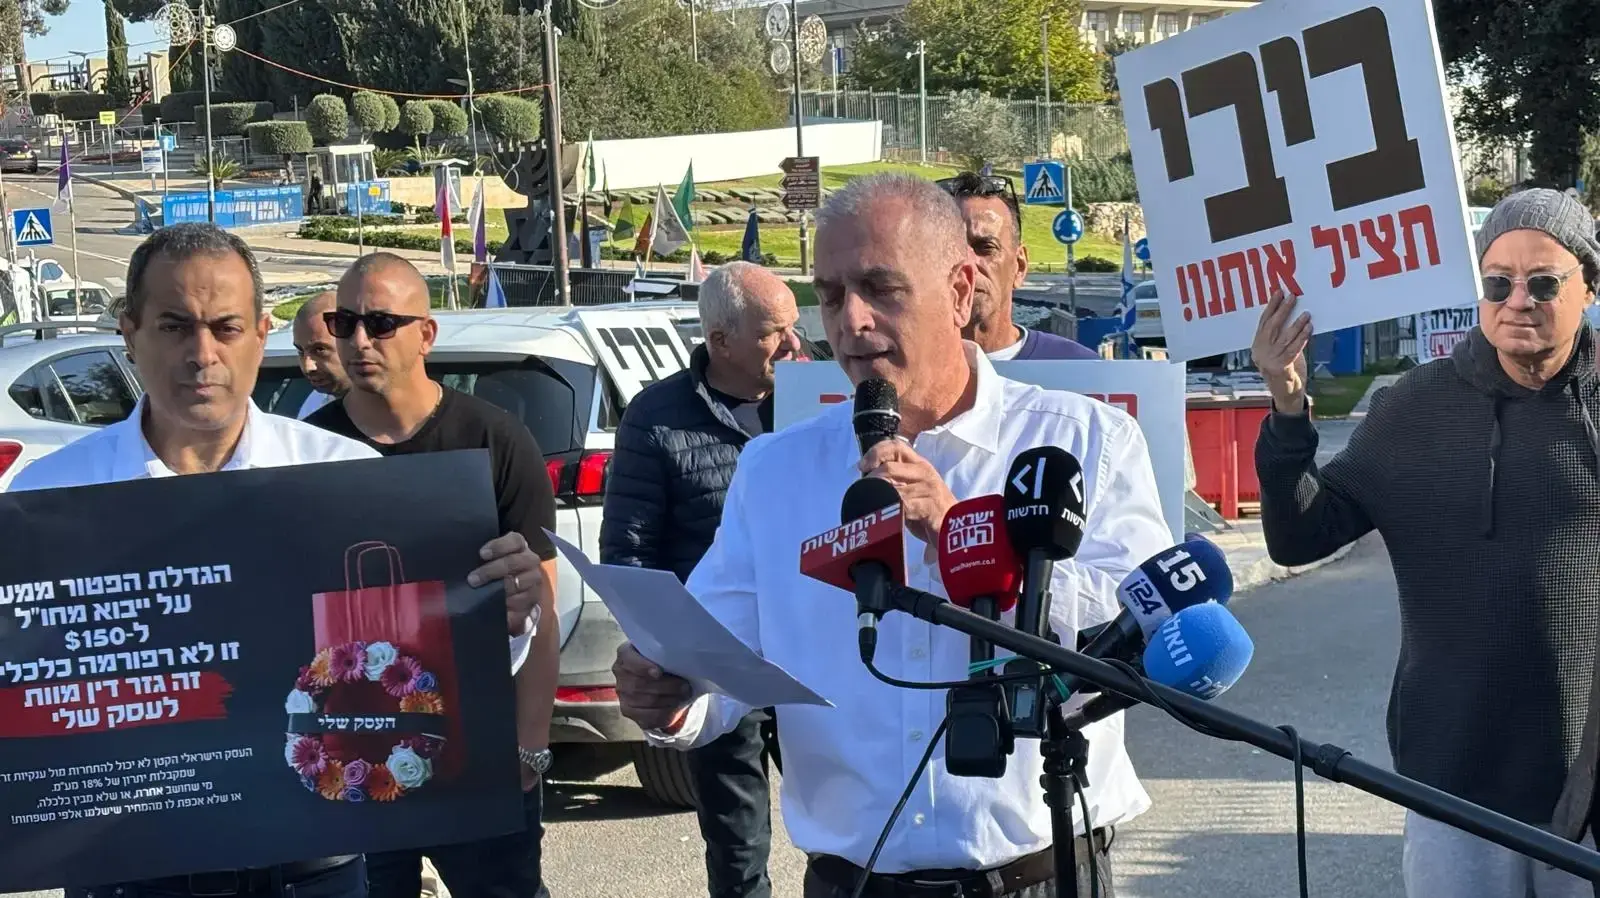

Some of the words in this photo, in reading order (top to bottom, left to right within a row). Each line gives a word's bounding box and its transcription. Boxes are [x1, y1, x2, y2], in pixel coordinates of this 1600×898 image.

[1143, 6, 1426, 243] ביבי
[1311, 204, 1441, 289] תציל
[1175, 239, 1304, 322] אותנו!
[1007, 504, 1049, 520] חדשות
[1061, 507, 1086, 530] דשות
[948, 510, 994, 530] ישראל
[803, 513, 877, 554] החדשות
[948, 524, 994, 552] היום
[832, 531, 868, 557] N12
[148, 564, 232, 590] הגדלת
[1156, 550, 1207, 592] 15
[60, 573, 141, 597] הפטור
[0, 581, 55, 605] ממע
[1125, 578, 1162, 615] i24
[94, 597, 151, 622] ייבוא
[156, 593, 192, 615] על
[14, 604, 87, 629] מחו"ל
[180, 641, 215, 665] לא
[221, 641, 240, 661] זו
[78, 648, 175, 675] רפורמה
[0, 657, 72, 683] כלכלי
[125, 674, 167, 695] גזר
[171, 671, 201, 692] זה
[24, 683, 81, 708] מוות
[86, 679, 119, 705] דין
[52, 707, 100, 729] שלי
[107, 696, 180, 728] לעסק
[318, 714, 350, 730] שלי
[354, 716, 396, 731] העסק
[180, 750, 222, 764] הישראלי
[224, 747, 253, 760] העסק
[68, 762, 114, 776] להתחרות
[115, 759, 136, 771] יכול
[137, 757, 151, 768] לא
[153, 754, 179, 769] הקטן
[13, 769, 47, 782] ענקיות
[49, 766, 66, 778] מול
[122, 773, 147, 786] יתרון
[149, 767, 196, 782] שמקבלות
[81, 777, 103, 789] 18%
[105, 776, 120, 787] של
[165, 781, 200, 795] שחושב
[201, 780, 213, 791] מי
[73, 794, 93, 807] מבין
[96, 790, 118, 802] שלא
[120, 791, 131, 800] או
[133, 787, 164, 800] אחרת,
[206, 792, 229, 804] שלא
[231, 791, 242, 801] או
[37, 796, 71, 809] כלכלה,
[124, 801, 163, 813] מהמחיר
[164, 798, 175, 809] לו
[177, 796, 204, 809] אכפת
[11, 811, 56, 825] משפחות!
[58, 807, 82, 820] אלפי
[84, 805, 122, 818] שישלמו
